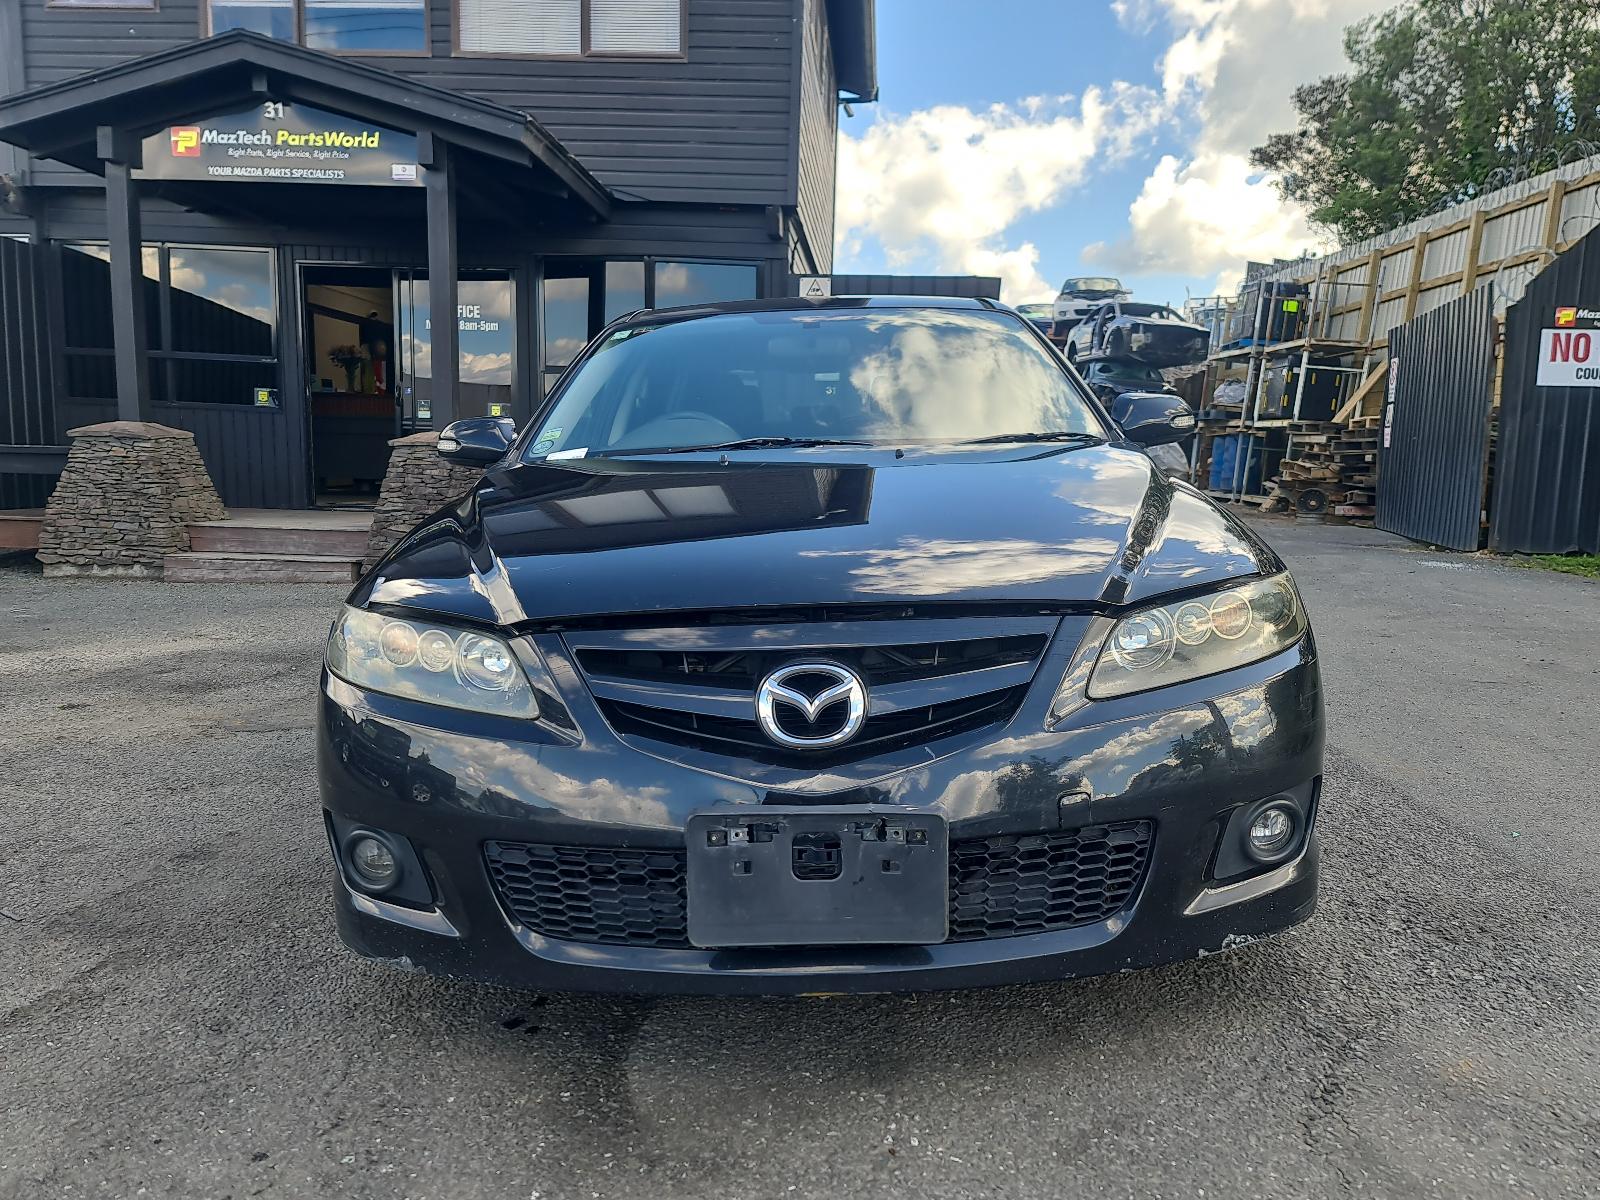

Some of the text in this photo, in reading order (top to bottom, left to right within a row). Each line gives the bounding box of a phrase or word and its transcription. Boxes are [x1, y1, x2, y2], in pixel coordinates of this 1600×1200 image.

[263, 101, 284, 119] 31
[201, 129, 272, 145] MazTech
[275, 130, 380, 148] PartsWorld
[332, 150, 350, 159] Price
[207, 166, 345, 179] YOUR MAZDA PARTS SPECIALISTS
[457, 304, 481, 319] FICE
[459, 320, 499, 332] 8am-5pm
[1549, 332, 1592, 363] NO
[1575, 367, 1600, 380] COU
